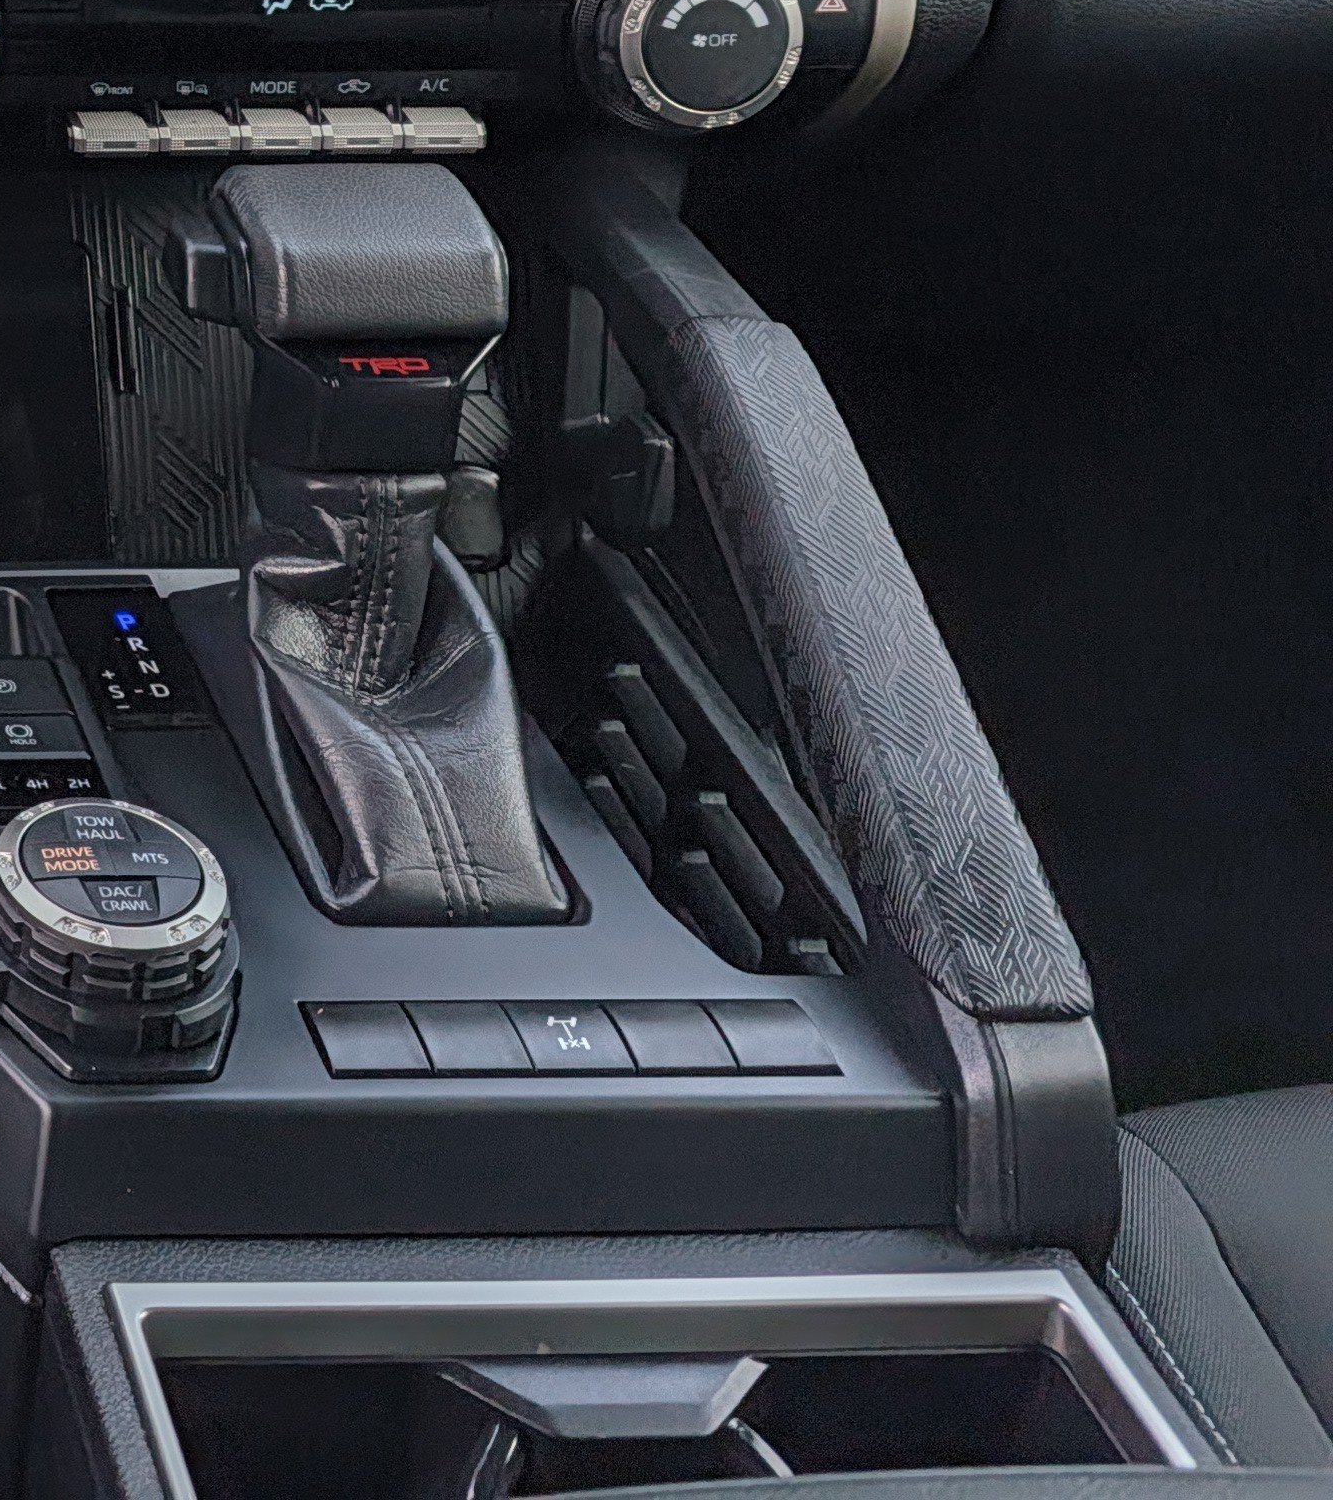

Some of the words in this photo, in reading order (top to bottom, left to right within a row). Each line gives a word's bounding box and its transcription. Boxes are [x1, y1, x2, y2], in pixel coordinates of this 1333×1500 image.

[708, 33, 738, 47] OFF
[250, 80, 297, 94] MODE
[420, 77, 450, 93] A/C
[338, 357, 431, 375] TRD
[116, 613, 136, 631] P
[127, 637, 149, 651] R
[138, 660, 160, 674] N
[108, 685, 125, 699] S
[150, 683, 170, 698] D
[26, 779, 49, 790] 4H
[67, 778, 91, 789] 2H
[74, 815, 114, 827] TOW
[76, 829, 125, 841] HAUL
[41, 846, 95, 859] DRIVE
[132, 852, 169, 865] MTS
[44, 859, 101, 873] MODE
[98, 885, 142, 898] DAC/
[101, 900, 152, 912] CRAWL
